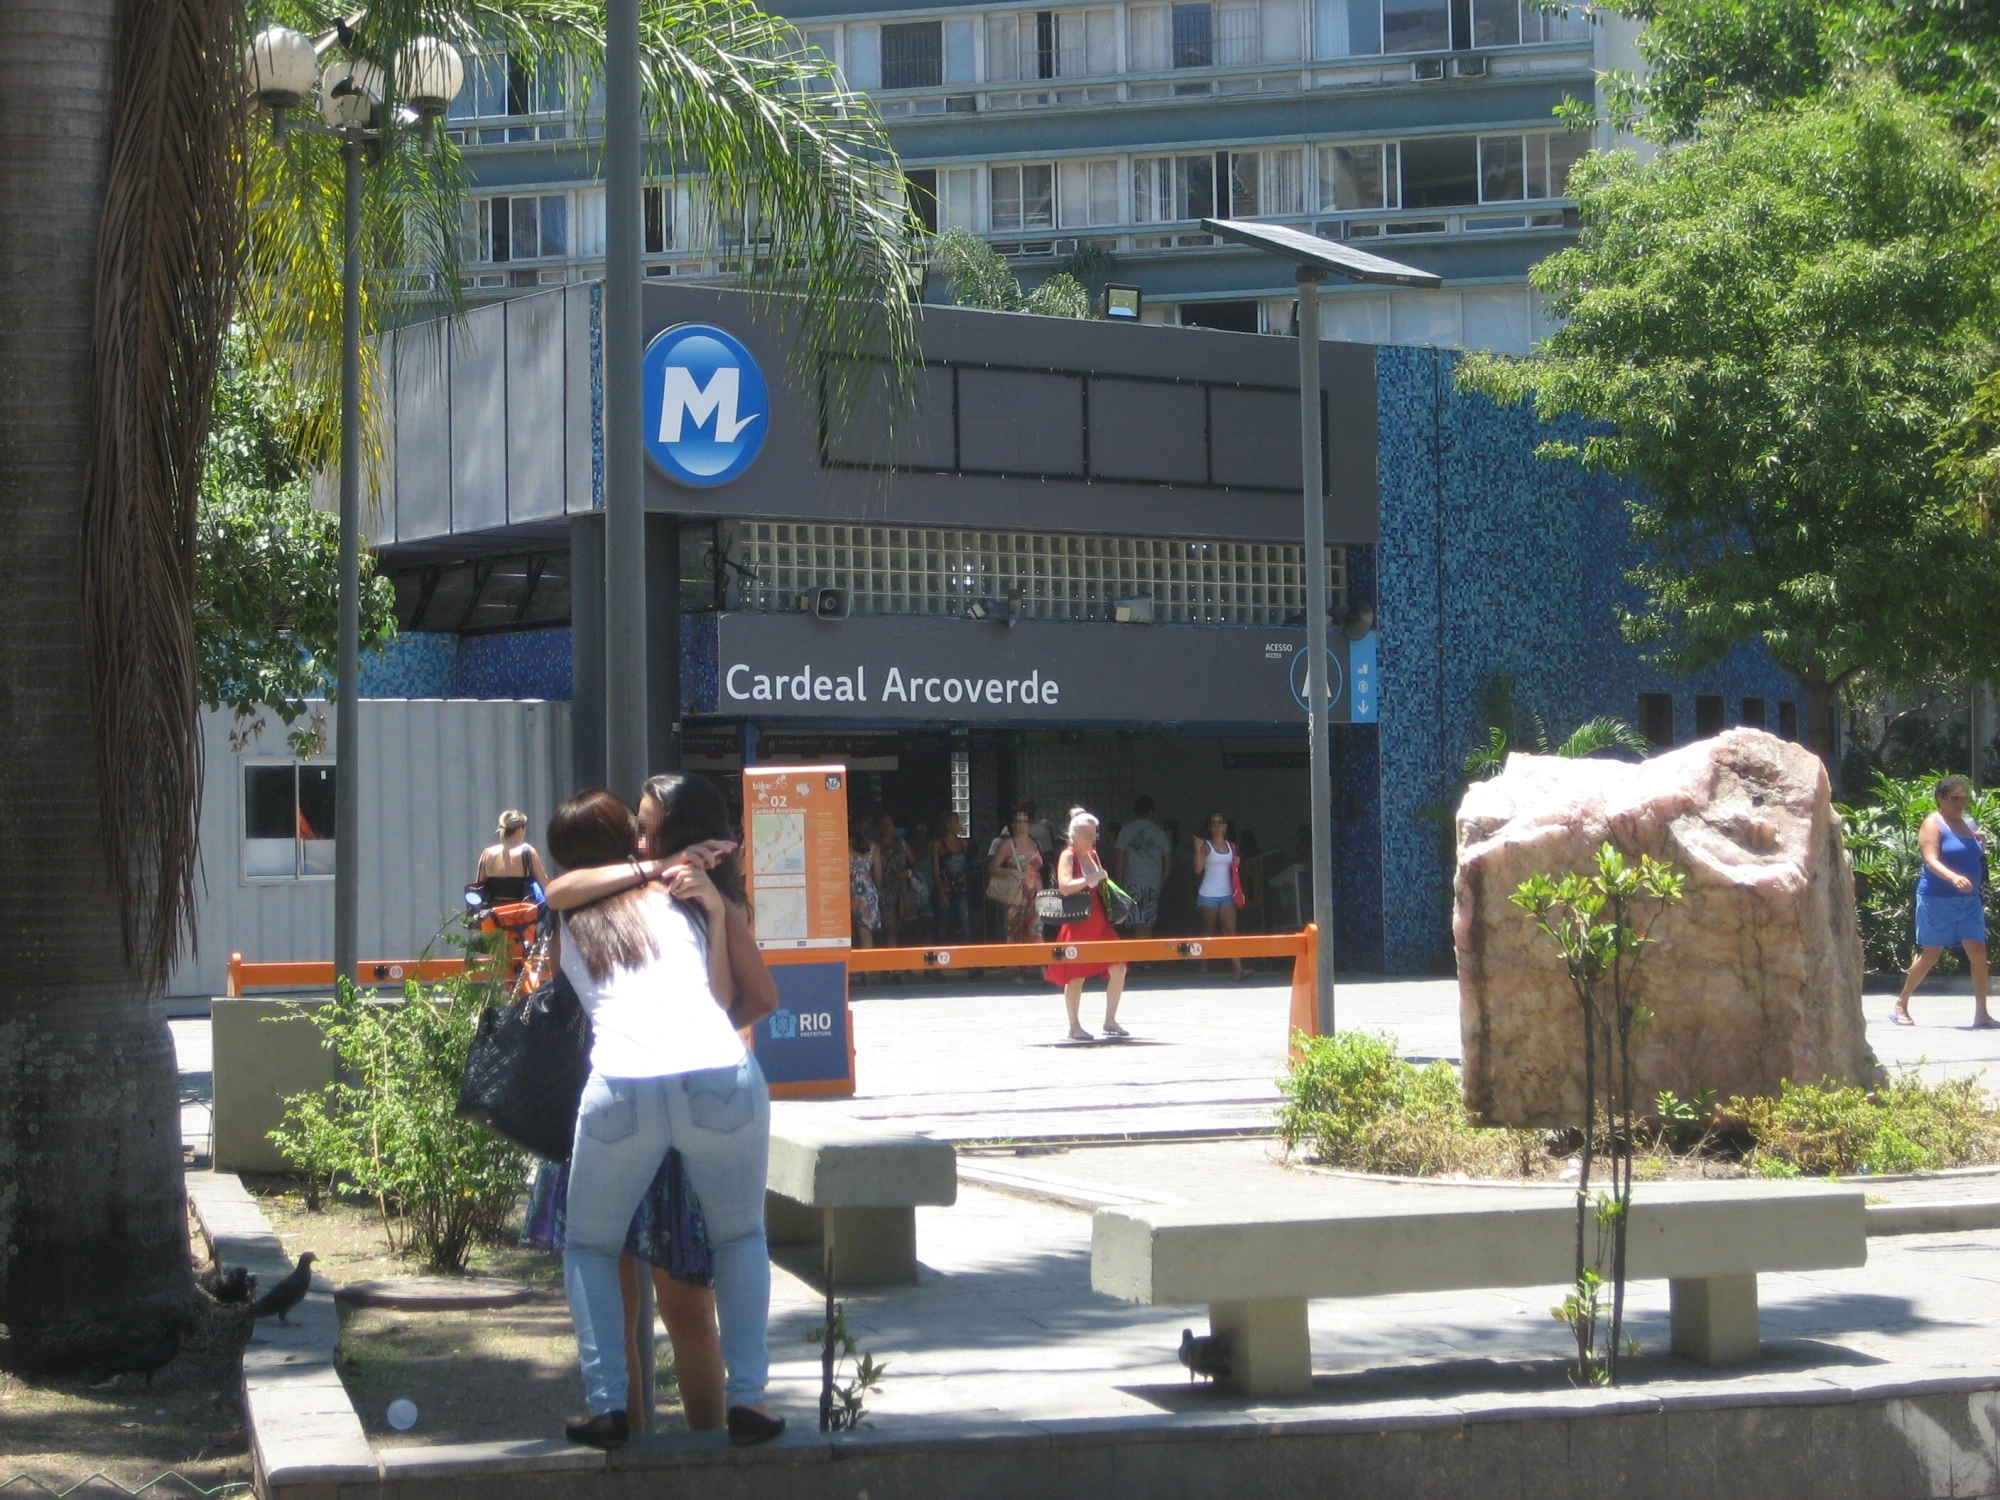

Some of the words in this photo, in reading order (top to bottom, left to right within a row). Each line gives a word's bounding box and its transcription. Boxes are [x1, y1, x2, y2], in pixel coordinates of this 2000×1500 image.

[1265, 643, 1293, 652] ACESSO
[726, 664, 867, 701] Cardeal
[882, 667, 1059, 704] Arcoverde
[752, 782, 771, 790] bike
[770, 795, 787, 807] 02
[799, 1012, 832, 1031] RIO
